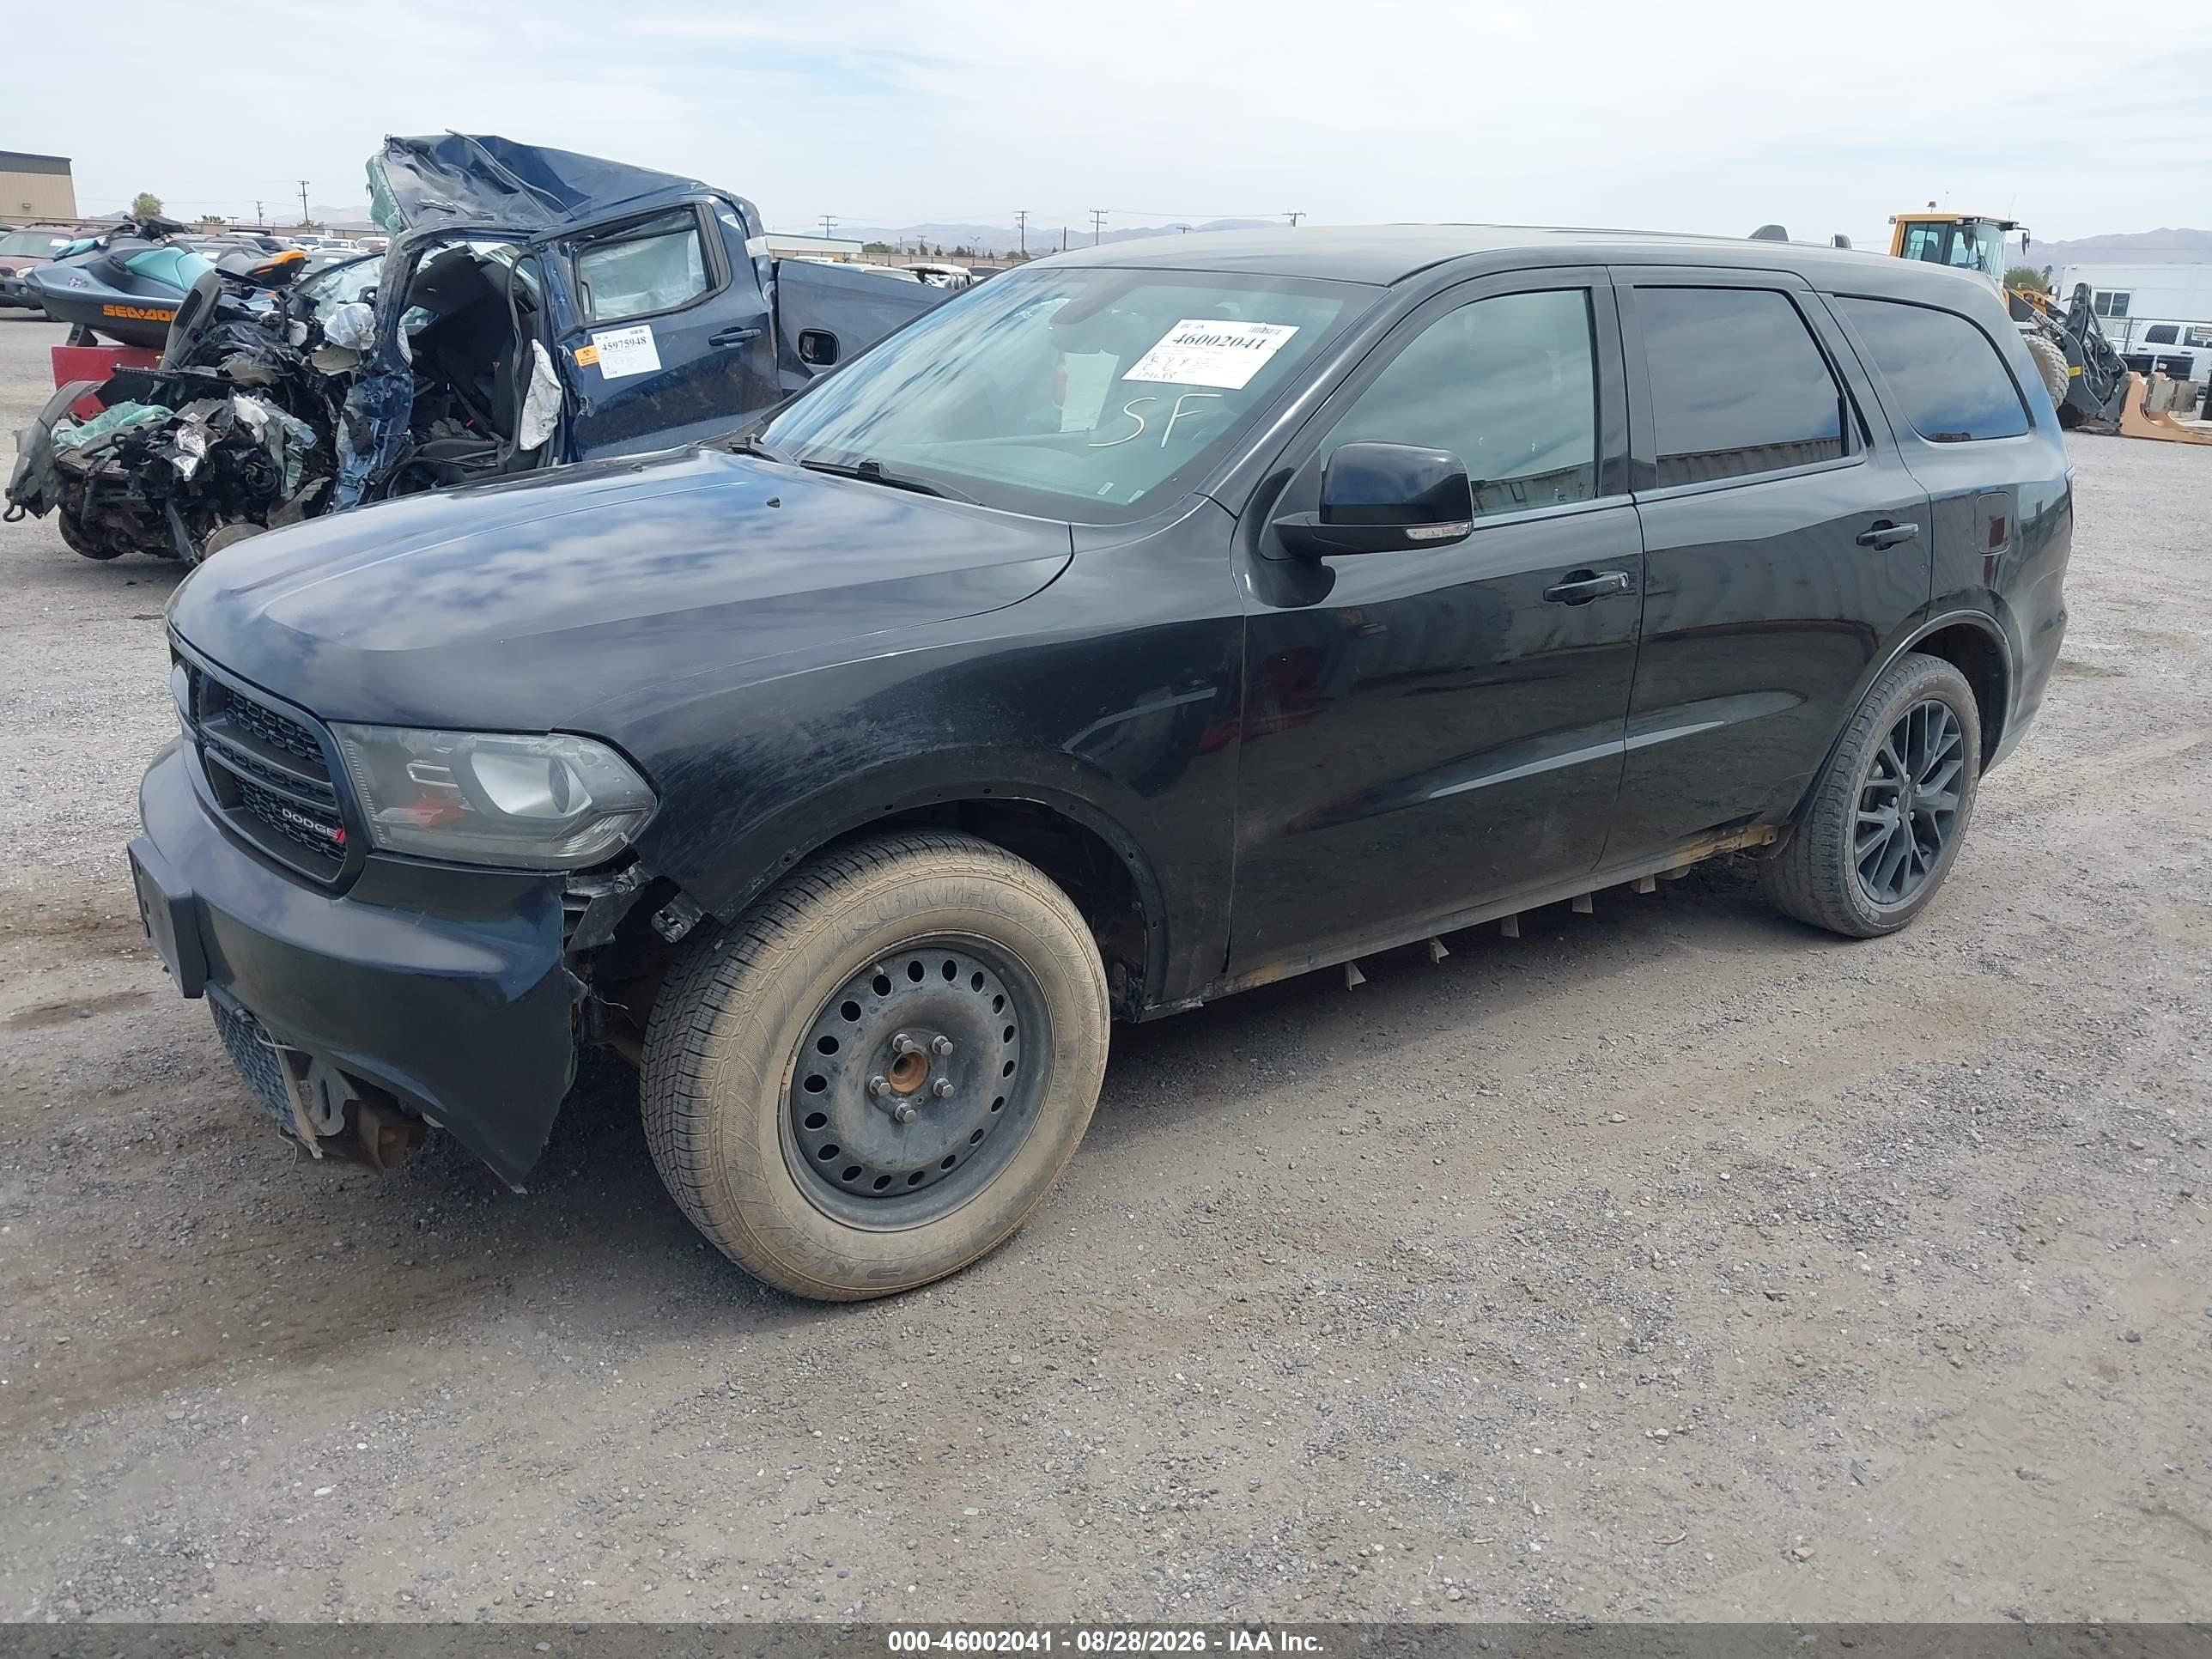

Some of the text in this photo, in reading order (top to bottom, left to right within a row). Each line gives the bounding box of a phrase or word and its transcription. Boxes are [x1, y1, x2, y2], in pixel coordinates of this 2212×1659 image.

[602, 336, 647, 351] 45975948
[1172, 333, 1267, 349] 46002041
[282, 808, 338, 839] DODGE
[836, 878, 1021, 945] KUMHO
